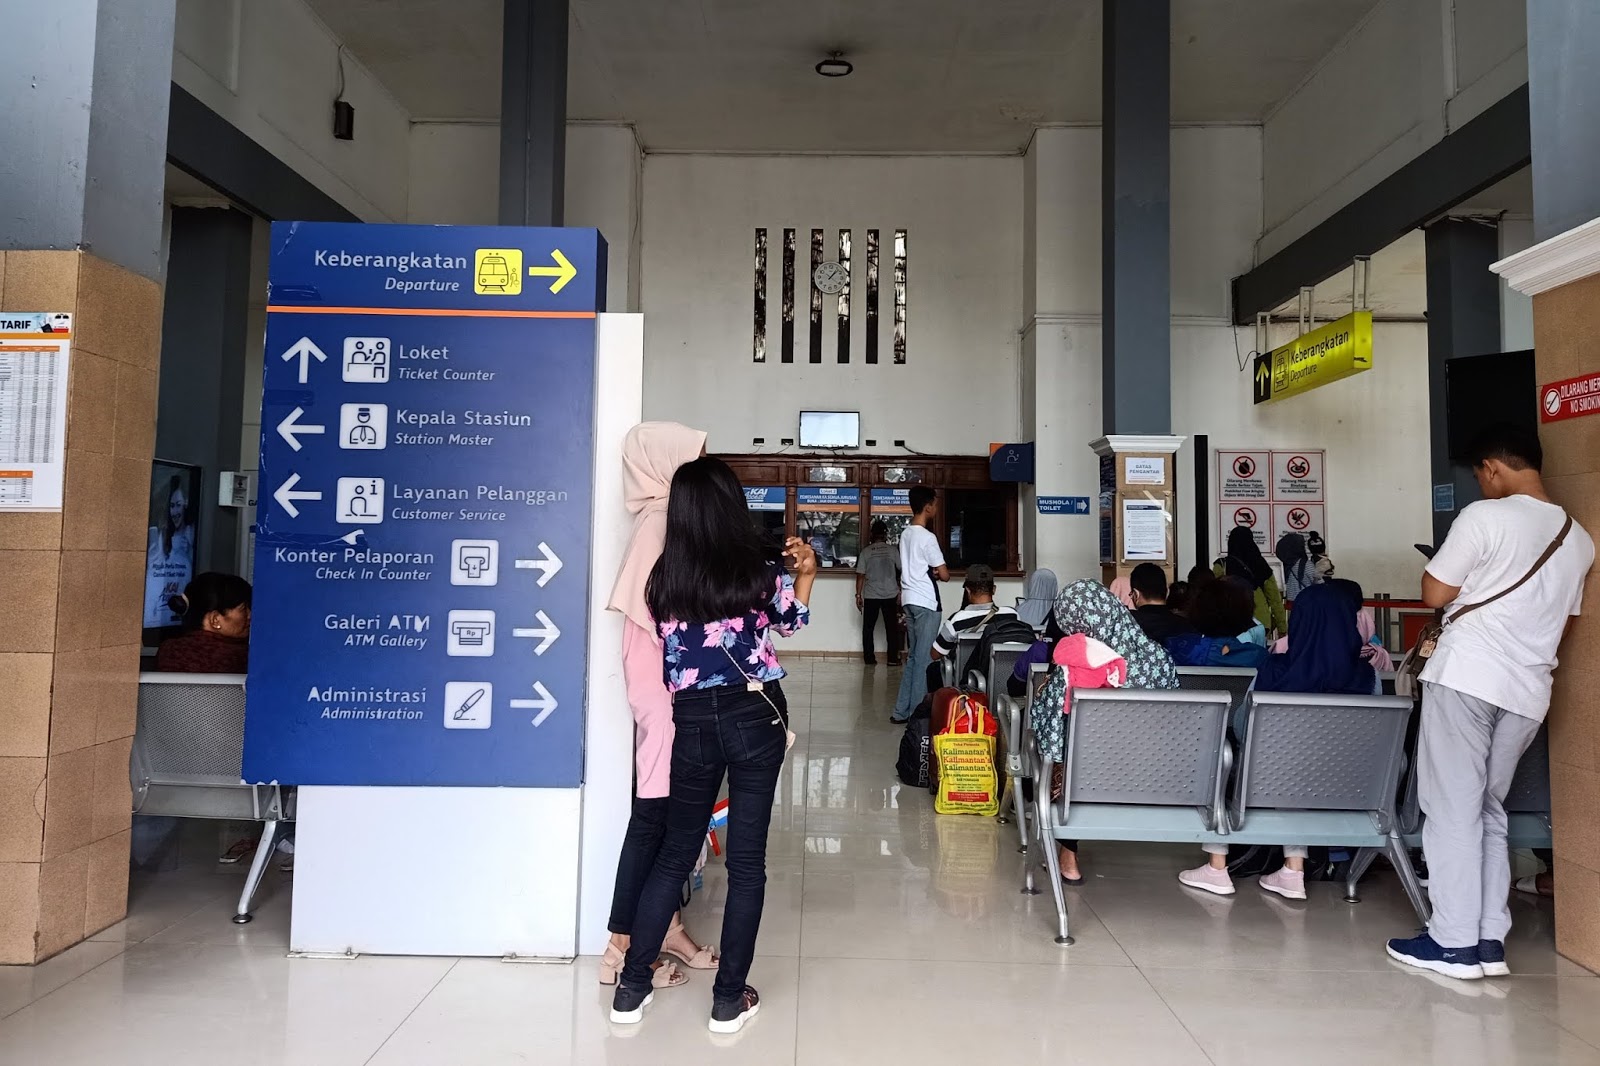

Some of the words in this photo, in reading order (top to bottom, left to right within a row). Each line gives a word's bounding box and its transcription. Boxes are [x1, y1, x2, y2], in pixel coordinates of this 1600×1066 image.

[315, 250, 466, 272] Keberangkatan
[385, 278, 459, 294] Departure
[0, 320, 31, 329] TARIF
[400, 345, 448, 359] Loket
[1291, 331, 1349, 364] Keberangkatan
[399, 368, 438, 379] Ticket
[443, 369, 495, 380] Counter
[1291, 364, 1317, 382] Departure
[1561, 380, 1588, 398] DILARANG
[1570, 399, 1579, 413] NO
[397, 410, 456, 428] Kepala
[465, 411, 530, 426] Stasiun
[395, 433, 443, 444] Station
[449, 434, 493, 445] Master
[900, 474, 906, 482] 3
[394, 485, 468, 503] Layanan
[478, 486, 567, 505] Pelanggan
[392, 508, 454, 519] Customer
[459, 509, 505, 520] Service
[276, 548, 337, 562] Konter
[344, 548, 434, 569] Pelaporan
[316, 567, 355, 579] Check
[361, 568, 373, 579] In
[378, 568, 431, 580] Counter
[325, 614, 380, 629] Galeri
[388, 615, 429, 632] ATM
[344, 635, 375, 645] ATM
[380, 635, 427, 650] Gallery
[308, 687, 426, 702] Administrasi
[321, 707, 423, 719] Administration
